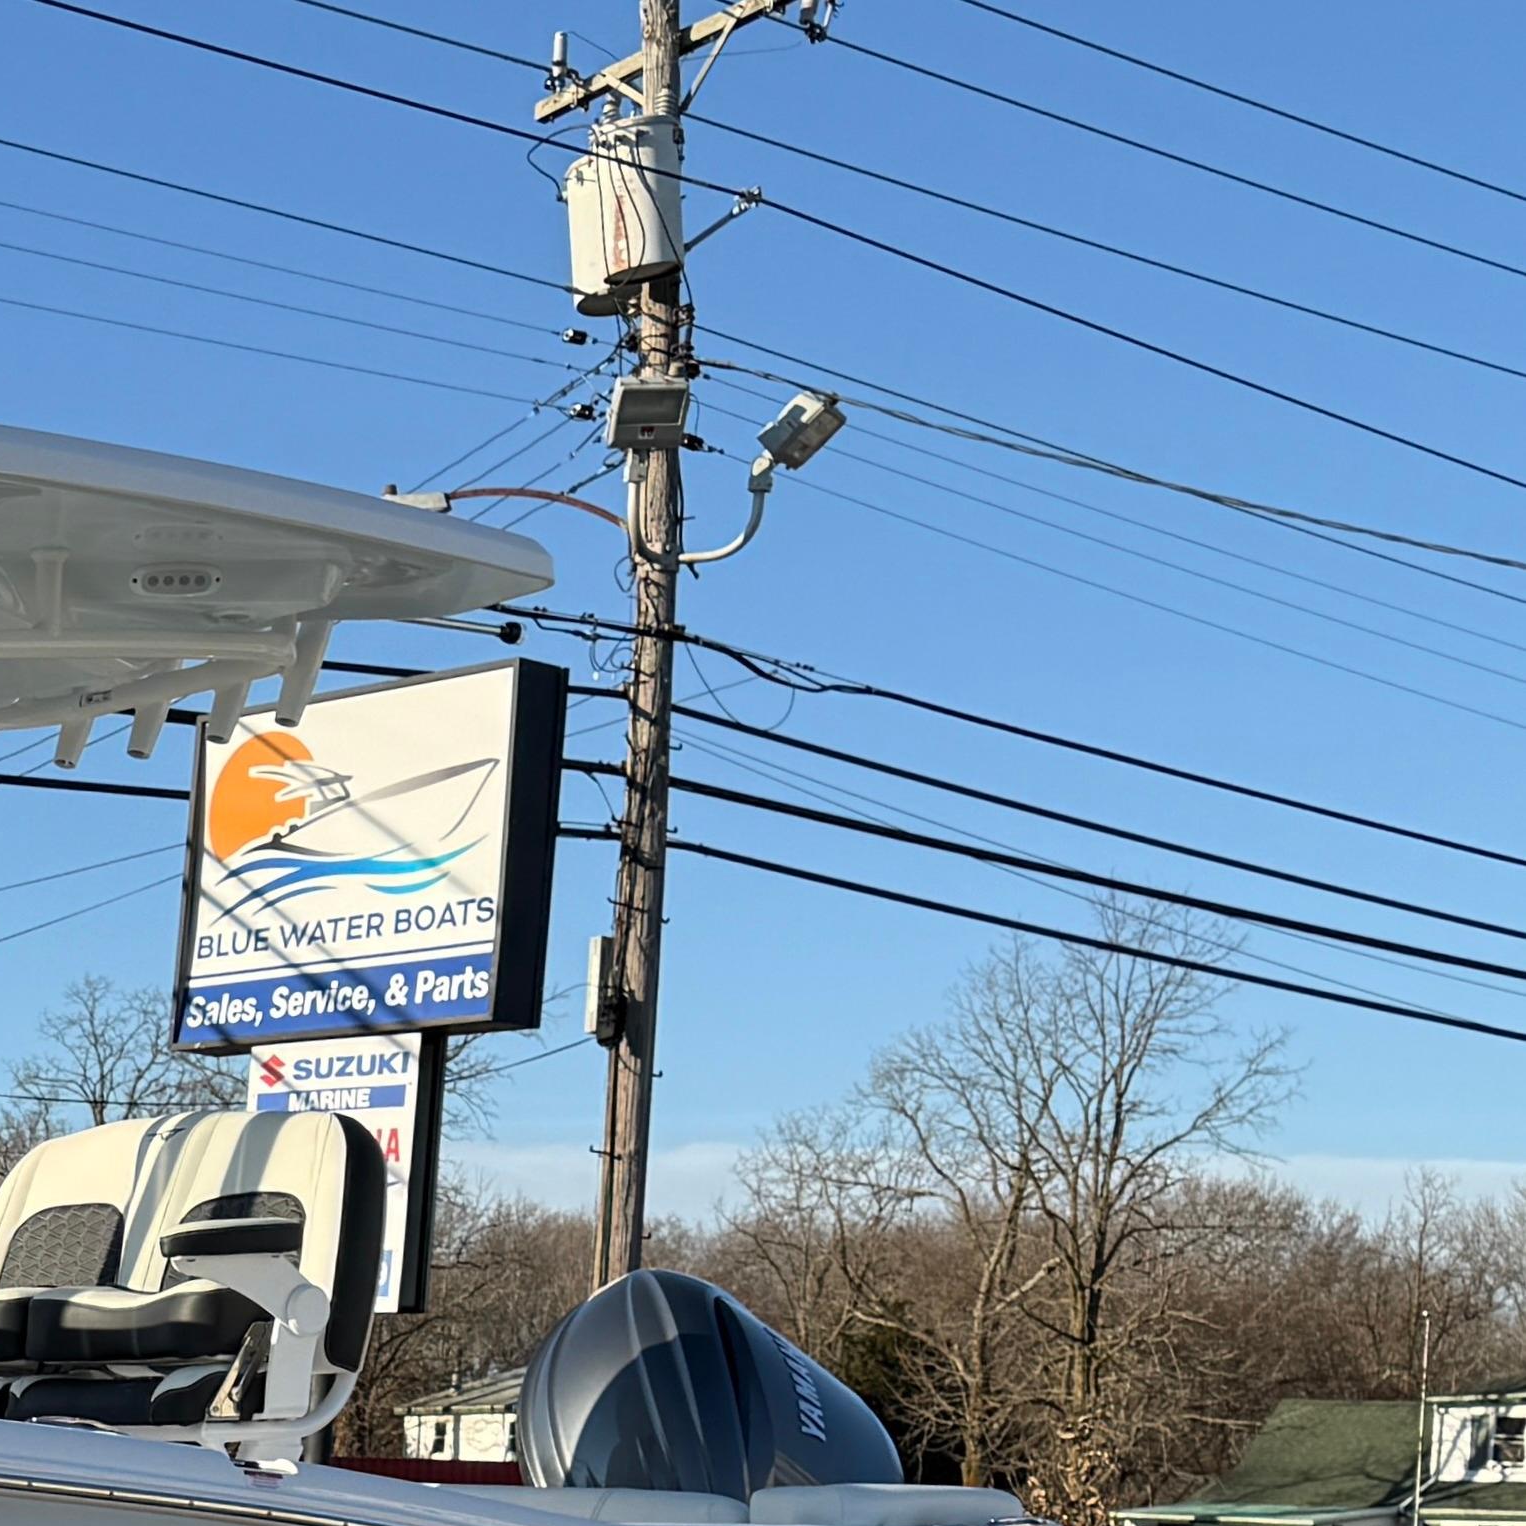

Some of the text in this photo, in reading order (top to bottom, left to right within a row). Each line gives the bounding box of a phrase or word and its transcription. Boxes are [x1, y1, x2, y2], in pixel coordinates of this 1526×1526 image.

[196, 896, 496, 960] BLUE WATER BOATS
[185, 965, 491, 1028] Sales, Service, & Parts
[292, 1051, 411, 1082] SUZUKI
[288, 1087, 372, 1112] MARINE
